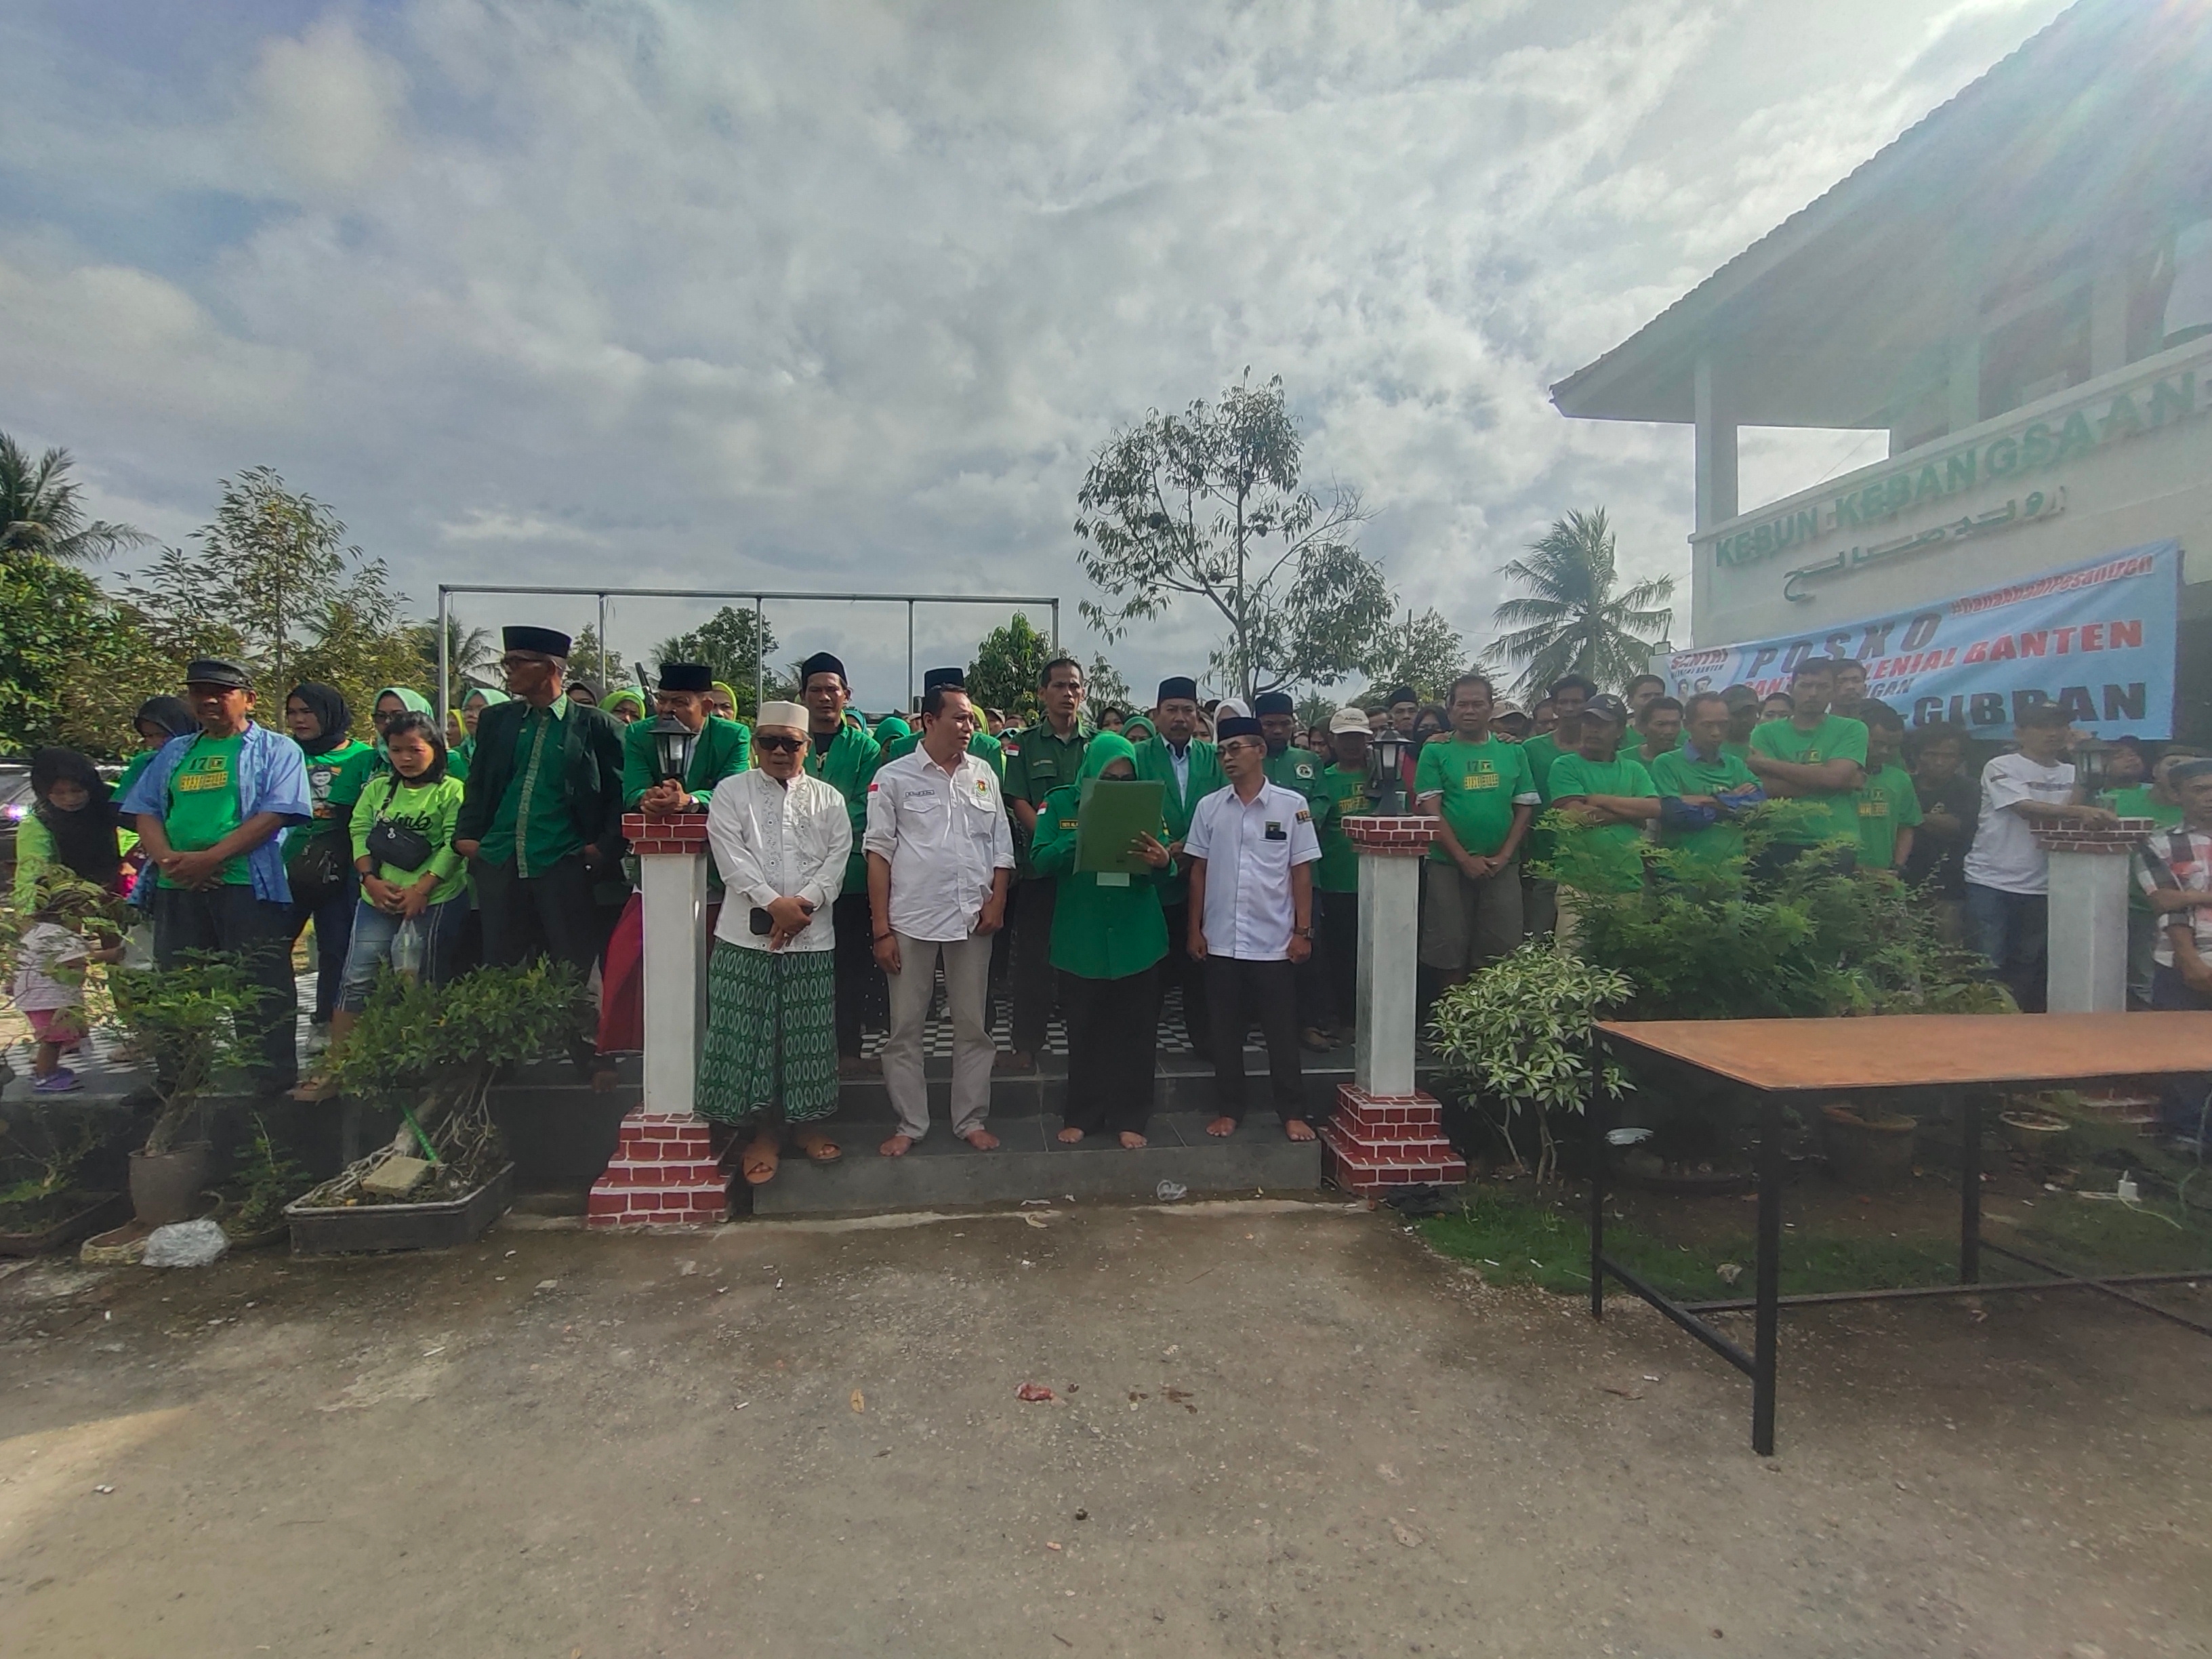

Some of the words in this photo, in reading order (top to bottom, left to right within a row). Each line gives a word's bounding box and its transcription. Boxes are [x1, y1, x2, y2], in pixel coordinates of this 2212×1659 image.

[1716, 507, 1818, 567] KEBUN
[1835, 371, 2195, 527] KEBANGSAAN
[1671, 648, 1729, 670] SANTRI
[1745, 613, 1942, 678] POSKO
[1963, 619, 2142, 664] BANTEN
